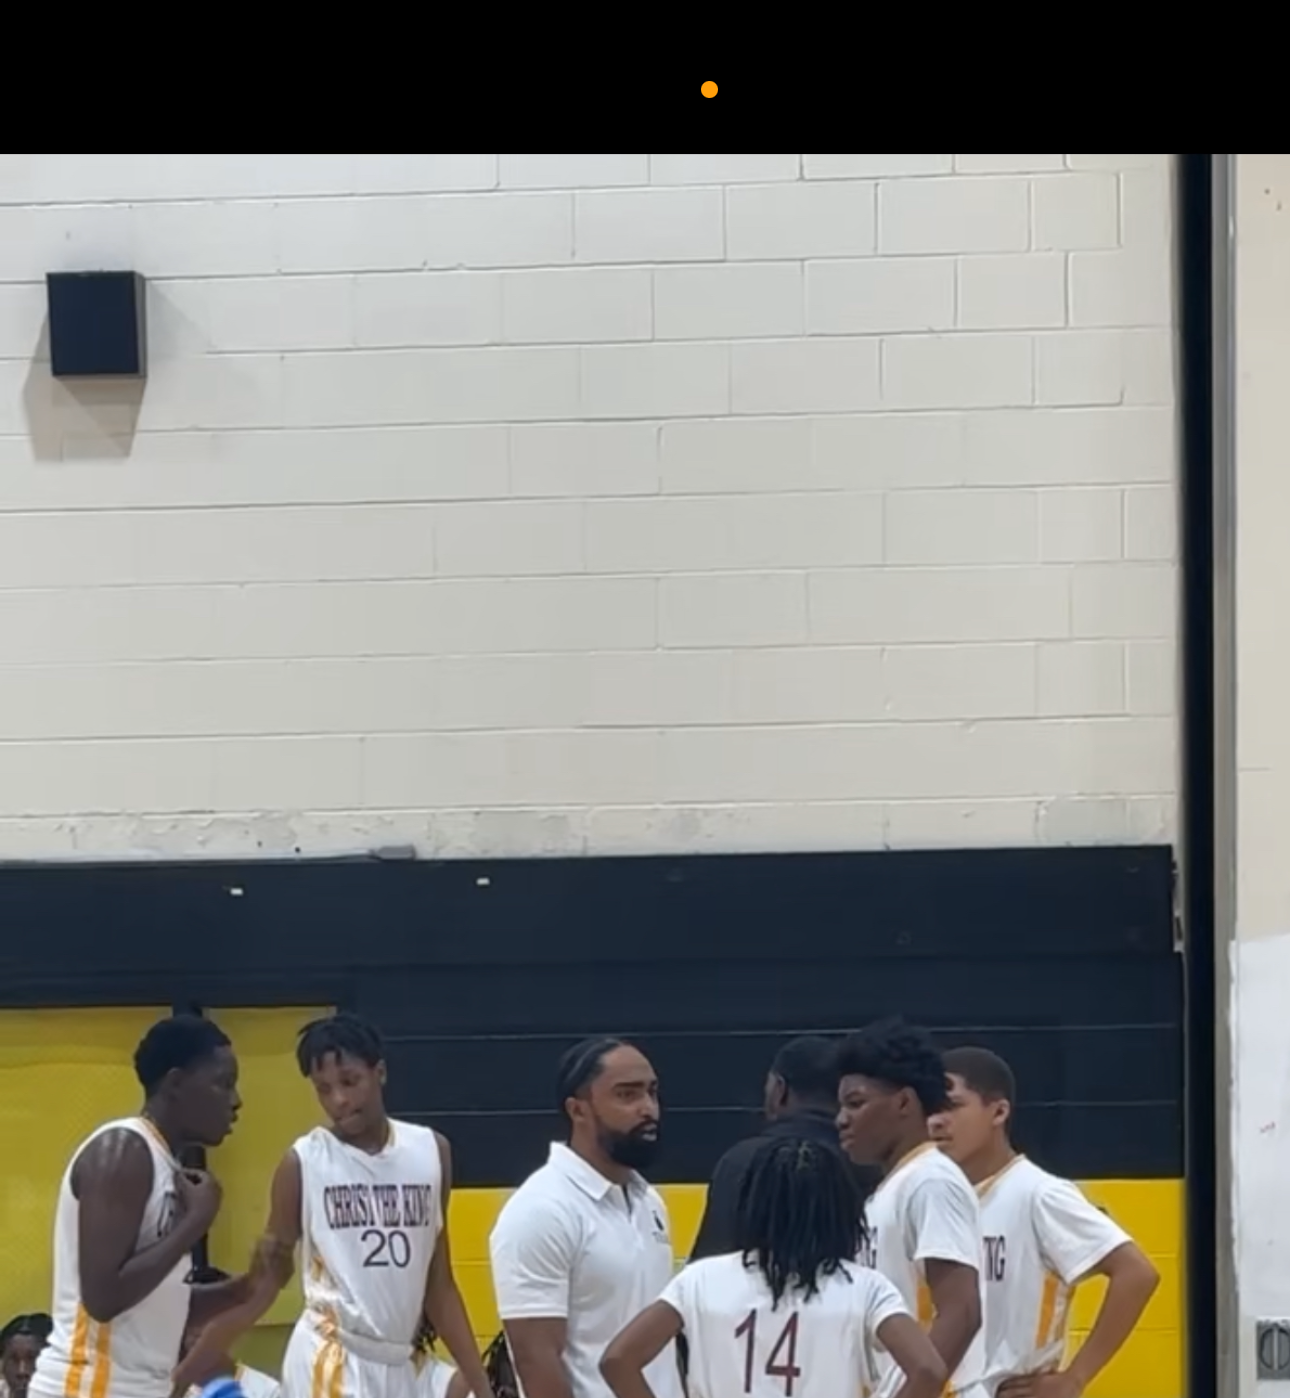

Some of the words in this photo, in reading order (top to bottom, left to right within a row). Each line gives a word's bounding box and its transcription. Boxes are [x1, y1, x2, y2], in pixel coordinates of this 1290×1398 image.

[323, 1184, 375, 1230] CHRIST
[372, 1184, 401, 1228] THE
[361, 1229, 411, 1269] 20
[734, 1308, 801, 1398] 14
